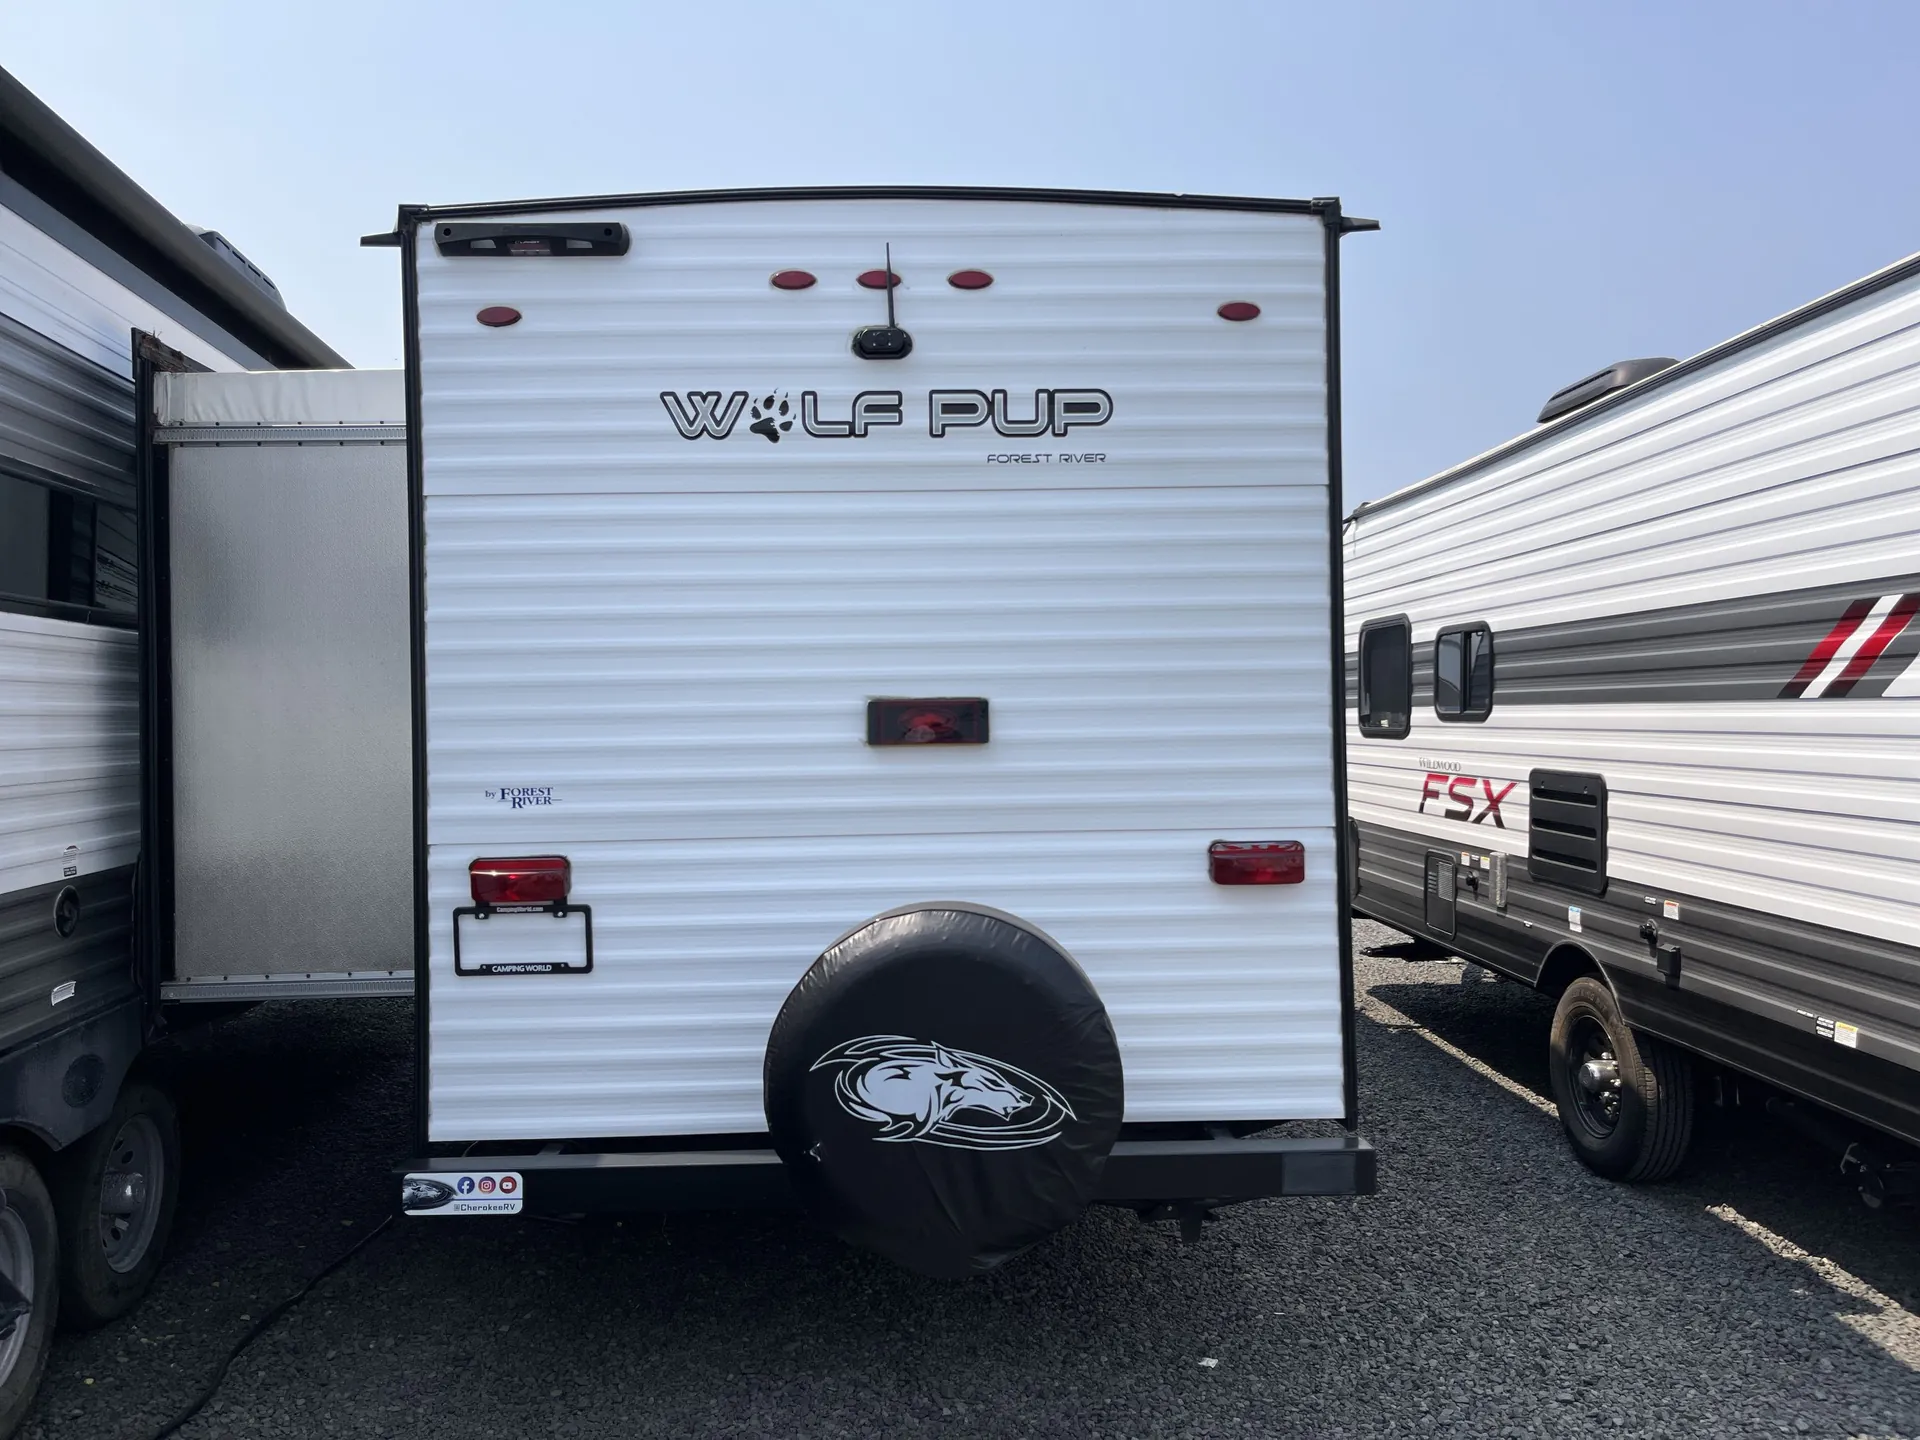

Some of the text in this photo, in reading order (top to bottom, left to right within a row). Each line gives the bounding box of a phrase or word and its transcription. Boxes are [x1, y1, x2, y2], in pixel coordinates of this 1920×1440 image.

[929, 389, 1114, 438] PUP
[987, 453, 1107, 464] FOREST RIVER
[1418, 757, 1462, 772] WILDWOOD
[485, 788, 553, 799] by FOREST
[512, 797, 551, 808] RIVER
[1418, 772, 1519, 830] FSX
